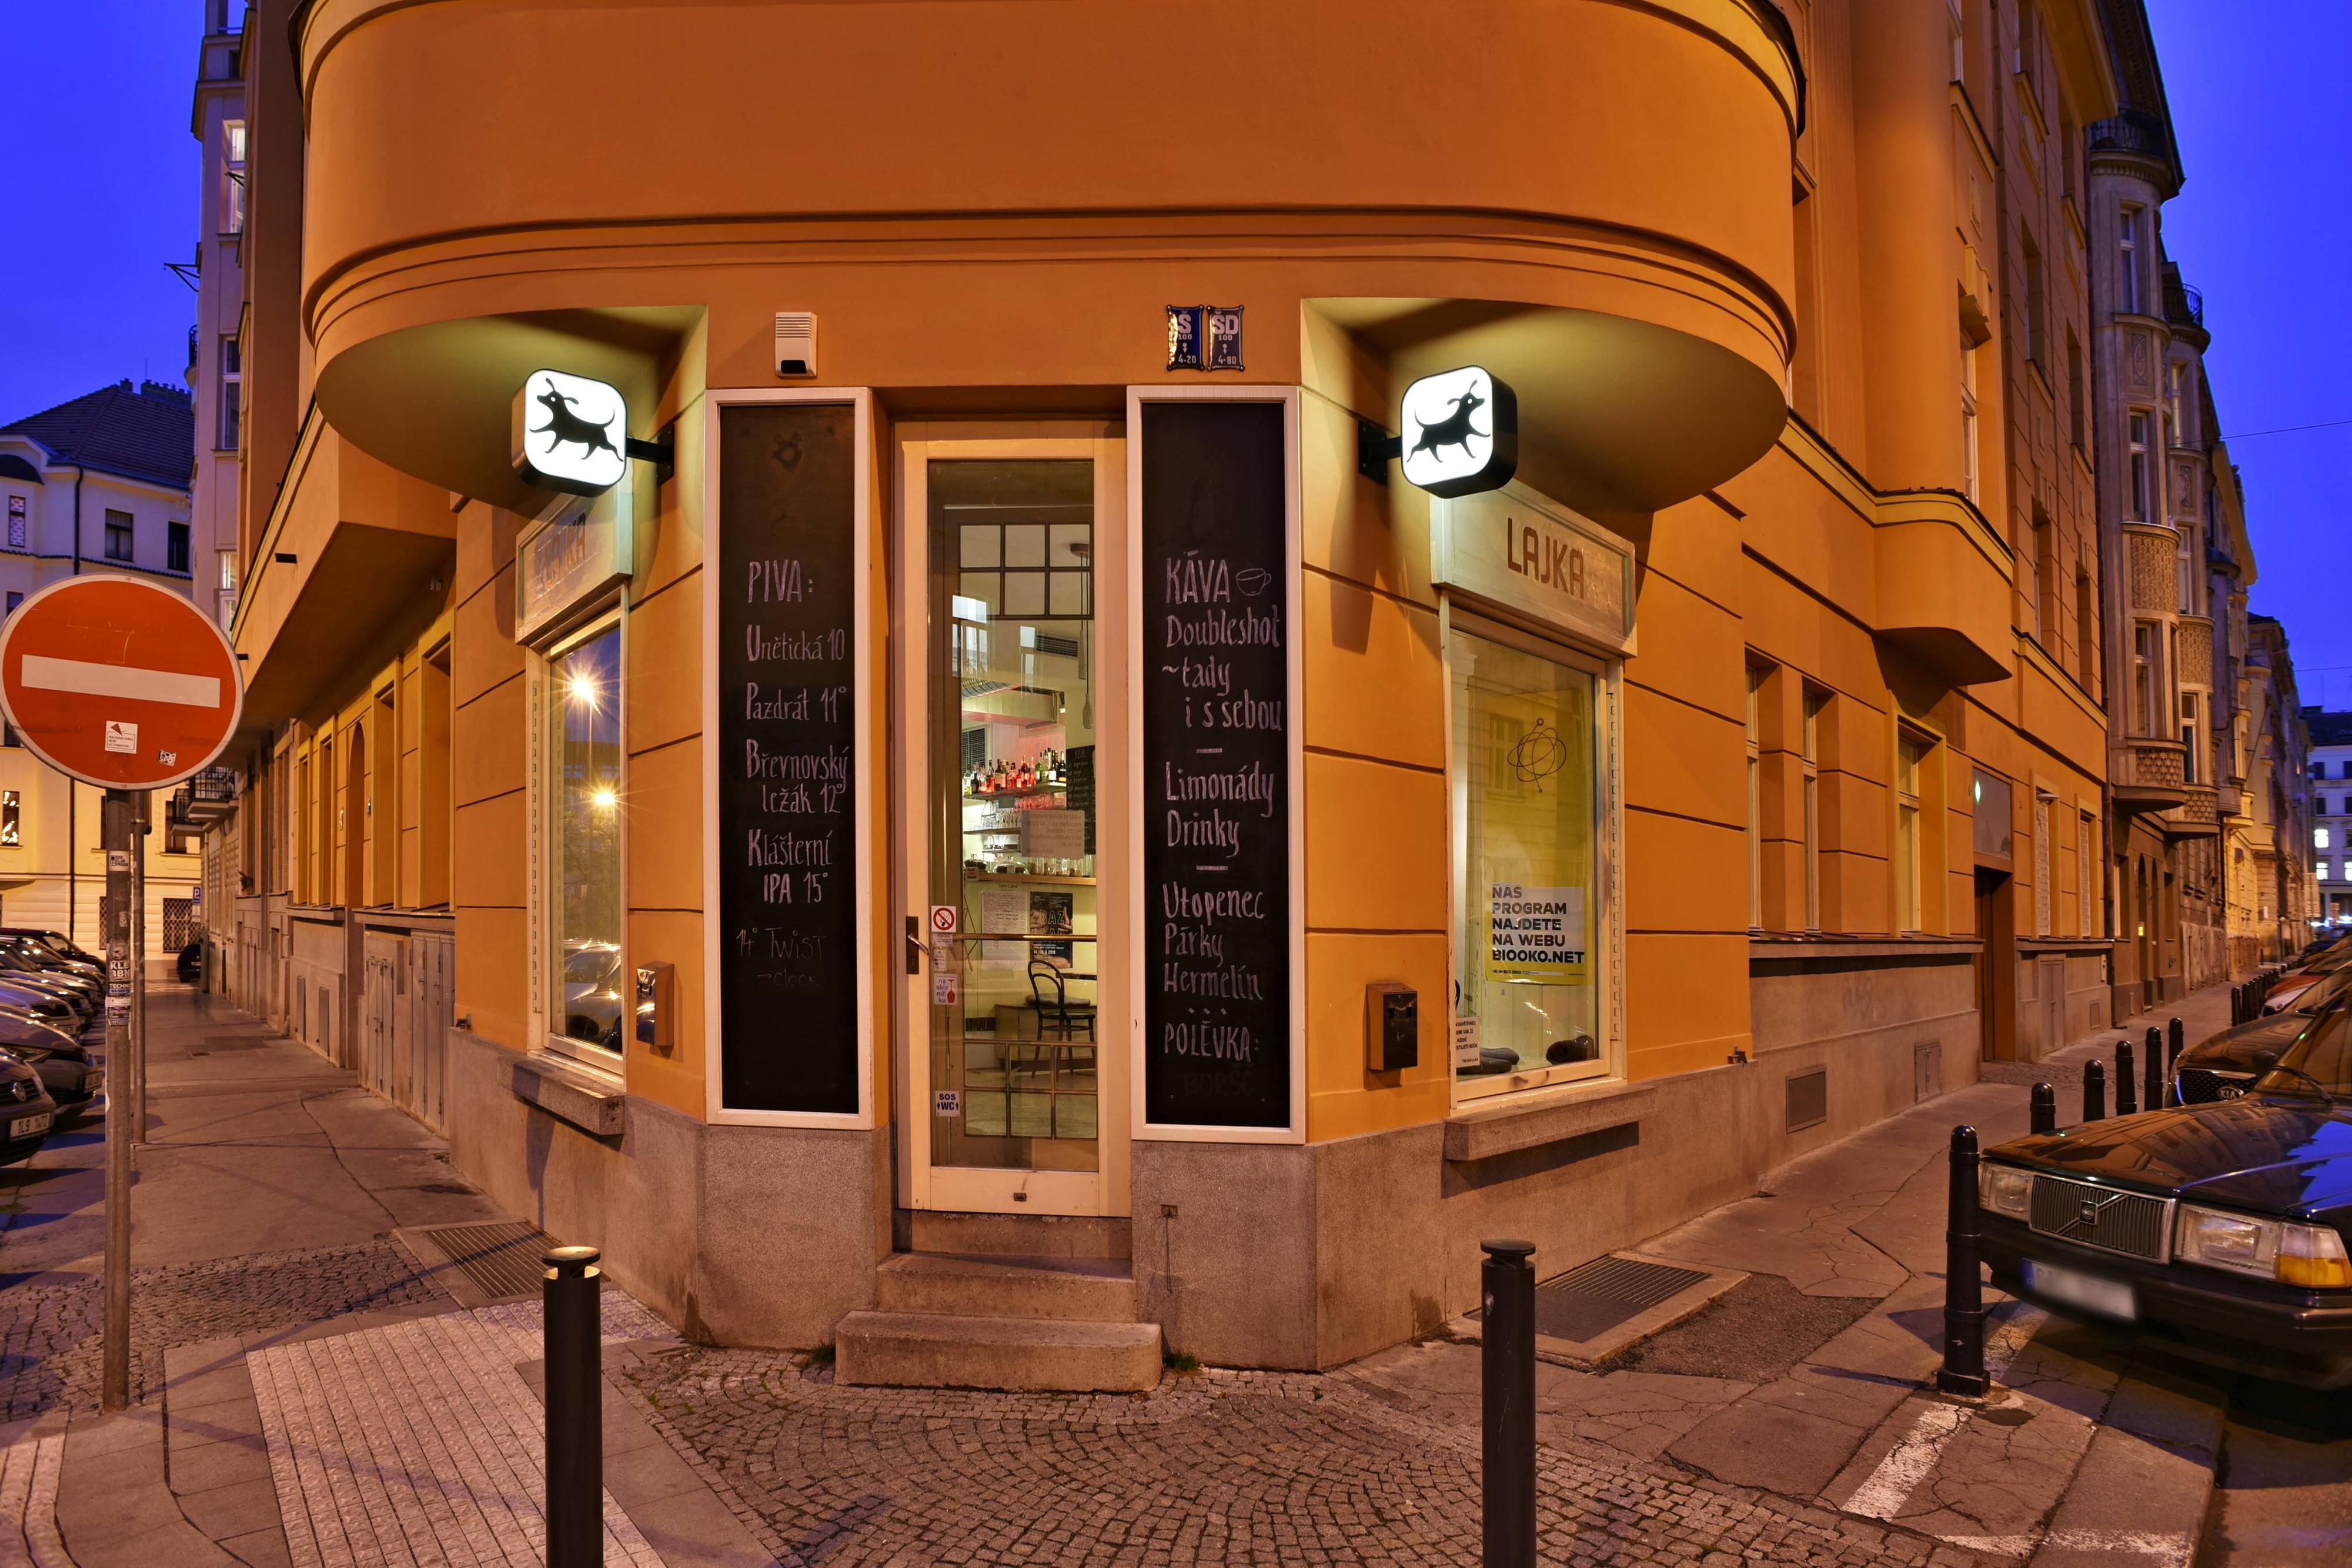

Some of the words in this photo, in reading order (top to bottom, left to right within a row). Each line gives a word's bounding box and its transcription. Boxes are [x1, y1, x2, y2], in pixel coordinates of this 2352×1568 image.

[1178, 310, 1191, 334] Š
[1212, 311, 1239, 335] ŠD
[1166, 550, 1230, 604] KÁVA
[1507, 517, 1585, 600] LAJKA
[747, 624, 823, 661] Unětická
[827, 628, 845, 660] 10
[1167, 605, 1279, 648] Doubleshot
[746, 682, 809, 721] Pazdrát
[1185, 696, 1192, 728] i
[1202, 701, 1214, 728] s
[1221, 689, 1282, 731] sebou
[746, 738, 849, 794] Břevnovský
[763, 784, 815, 814] ležák
[1166, 761, 1274, 818] Limonády
[748, 829, 833, 867] Klášterní
[1167, 808, 1240, 858] Drinky
[764, 873, 791, 904] IPA
[1162, 881, 1265, 926] Utopenec
[1492, 884, 1522, 899] NÁŠ
[1492, 902, 1566, 915] PROGRAM
[1492, 918, 1562, 931] NAJDETE
[1165, 922, 1223, 968] Párky
[1492, 934, 1514, 945] NA
[1519, 934, 1565, 947] WEBU
[1492, 950, 1585, 964] BIOOKO.NET
[1164, 962, 1264, 1001] Hermelín
[941, 1102, 954, 1111] WC
[2220, 1089, 2236, 1099] KIA
